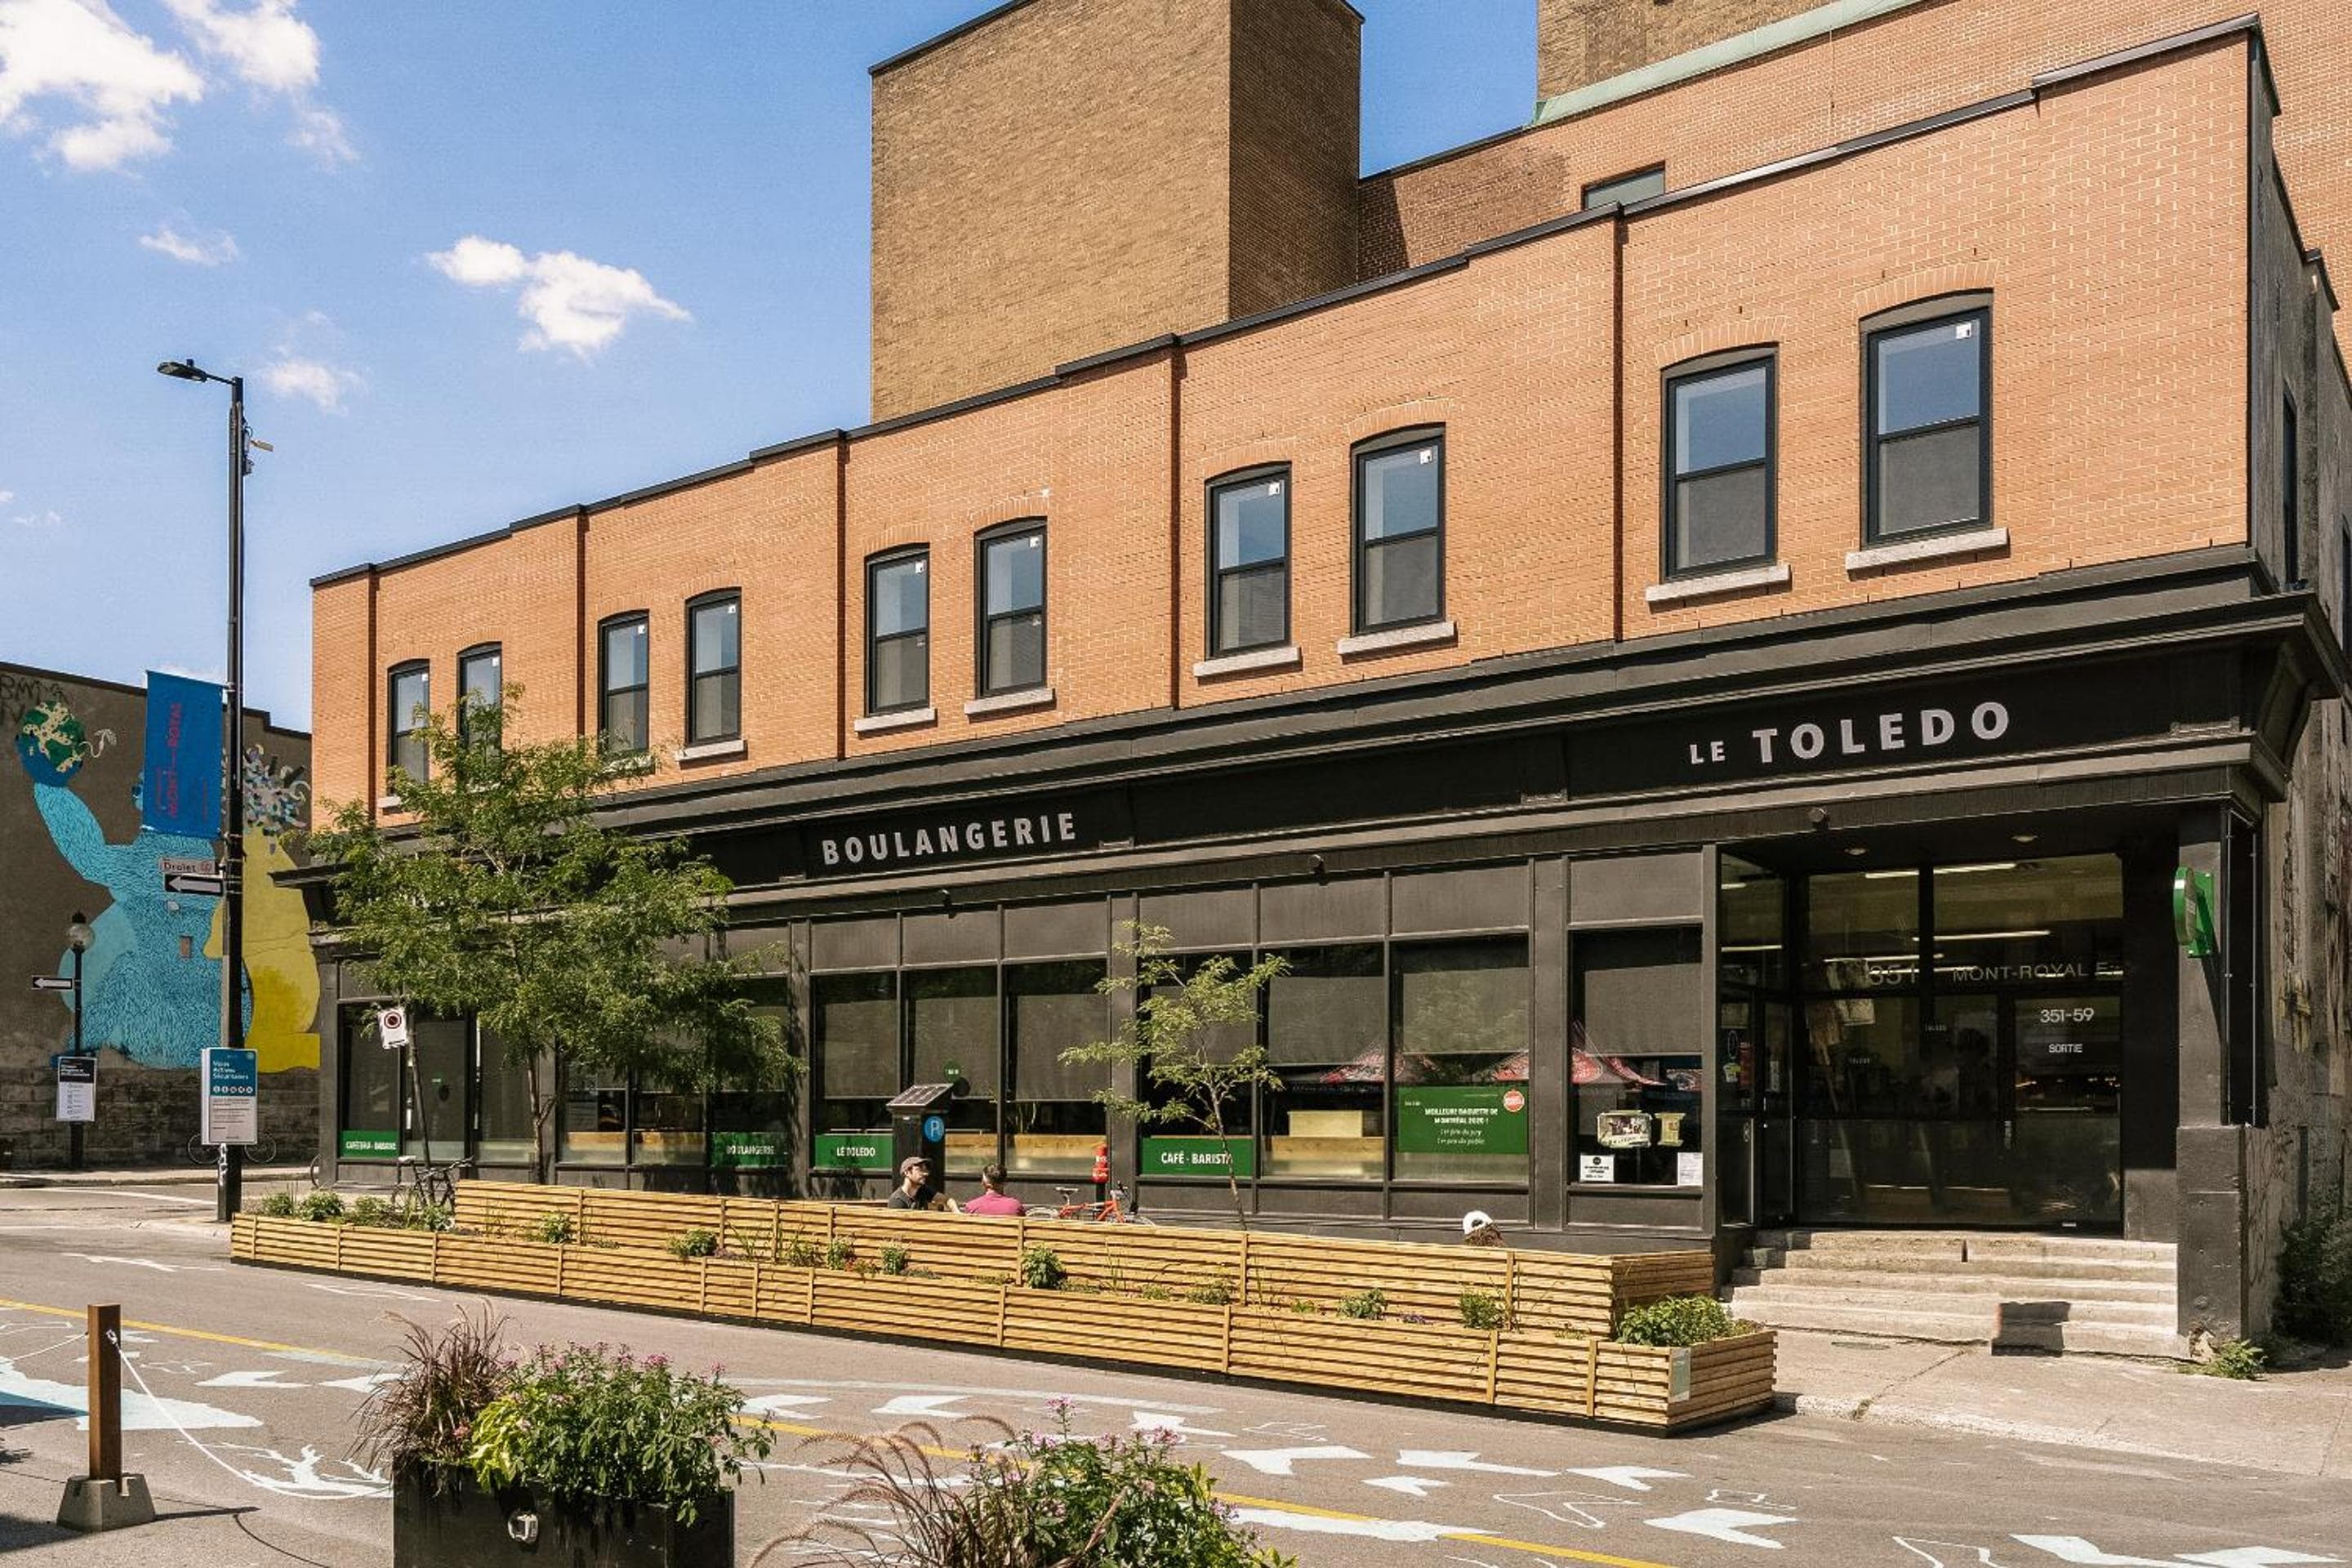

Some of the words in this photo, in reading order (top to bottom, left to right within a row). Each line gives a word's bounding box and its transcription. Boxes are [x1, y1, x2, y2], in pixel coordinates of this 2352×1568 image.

[1690, 741, 1726, 764] LE
[1752, 702, 2009, 763] TOLEDO
[822, 813, 1076, 865] BOULANGERIE
[163, 862, 196, 872] Drolet
[1953, 963, 2089, 982] MONT-ROYAL
[2040, 1007, 2095, 1023] 351-59
[2048, 1043, 2083, 1054] SORTIE
[1160, 1151, 1185, 1164] CAFÉ
